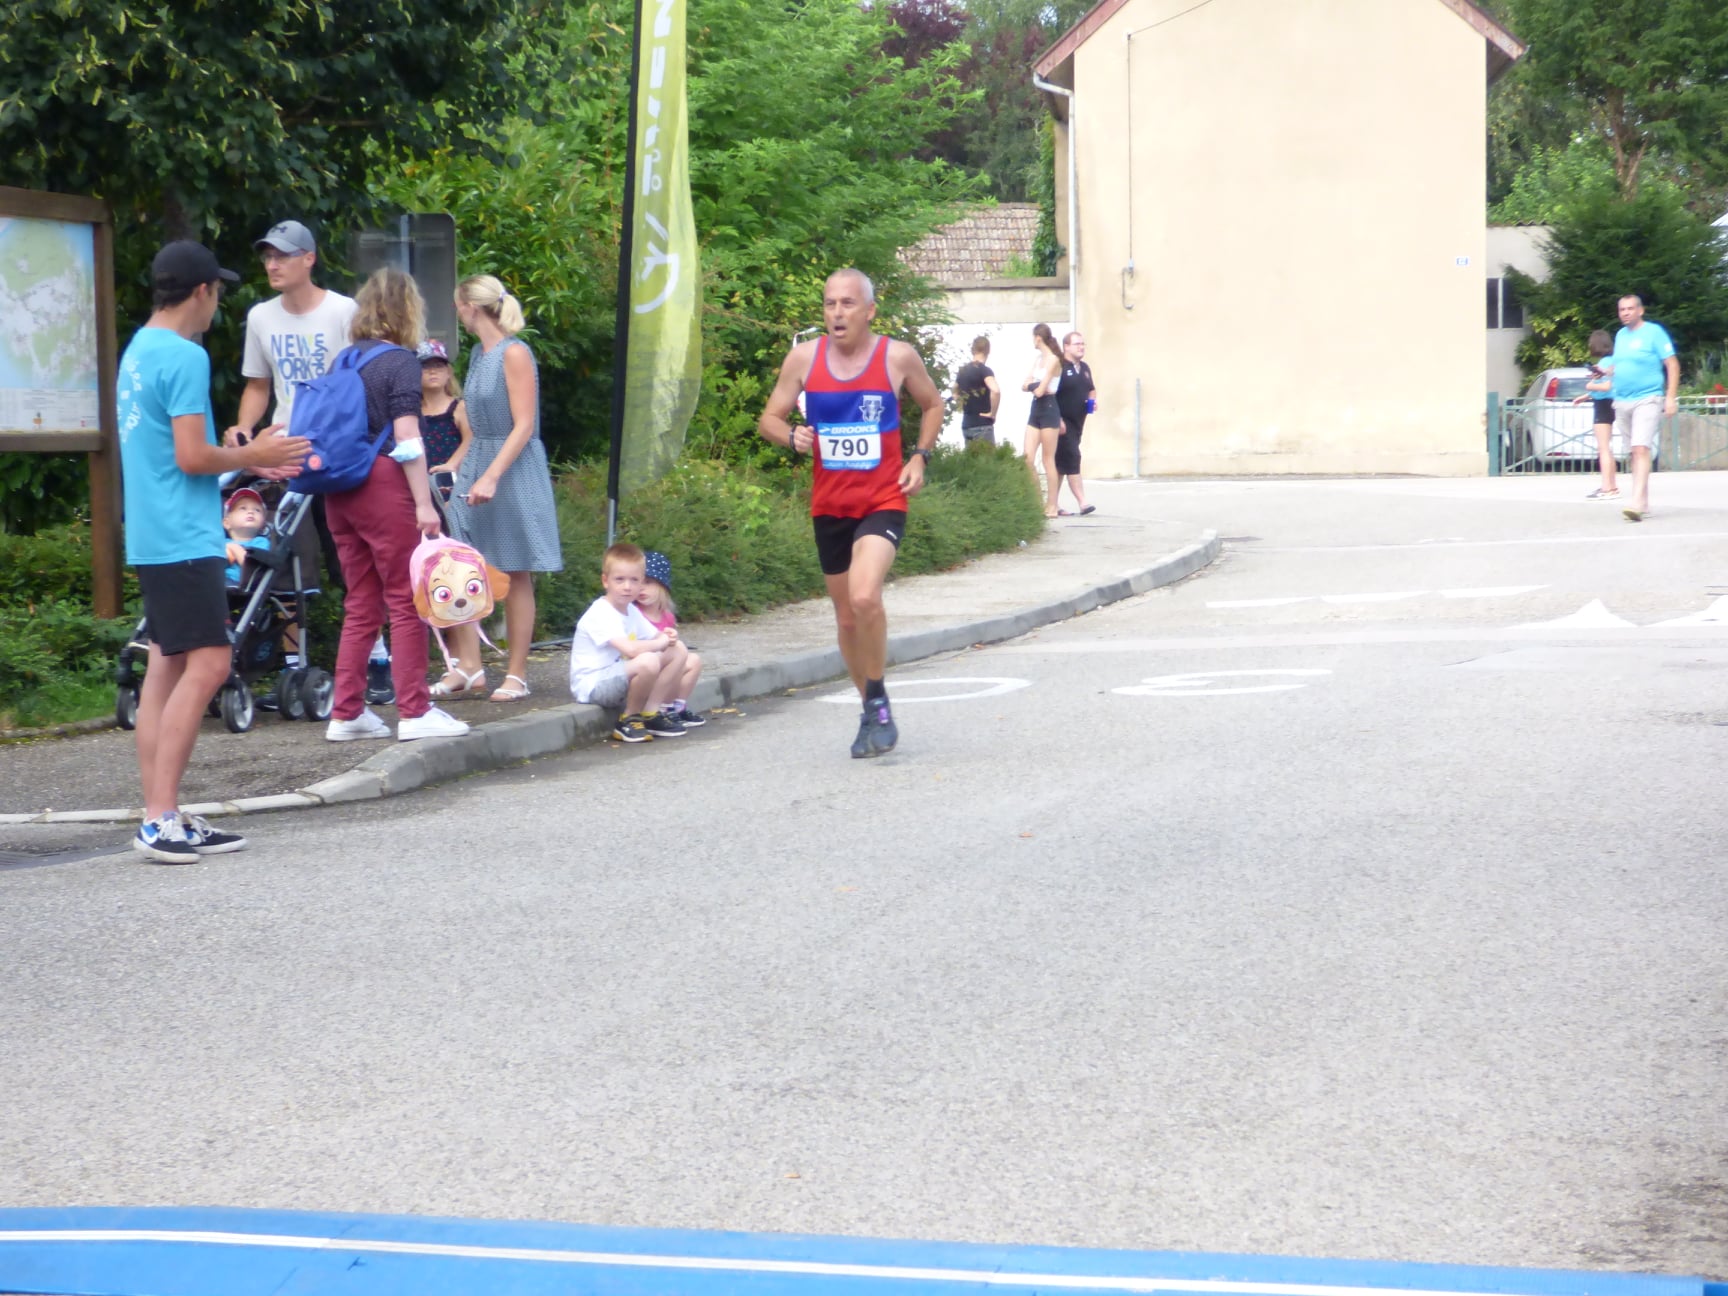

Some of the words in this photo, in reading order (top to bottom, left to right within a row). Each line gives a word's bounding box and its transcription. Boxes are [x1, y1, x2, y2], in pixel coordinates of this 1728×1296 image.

[270, 333, 311, 358] NEW
[311, 332, 329, 377] oklyn
[828, 438, 869, 457] 790
